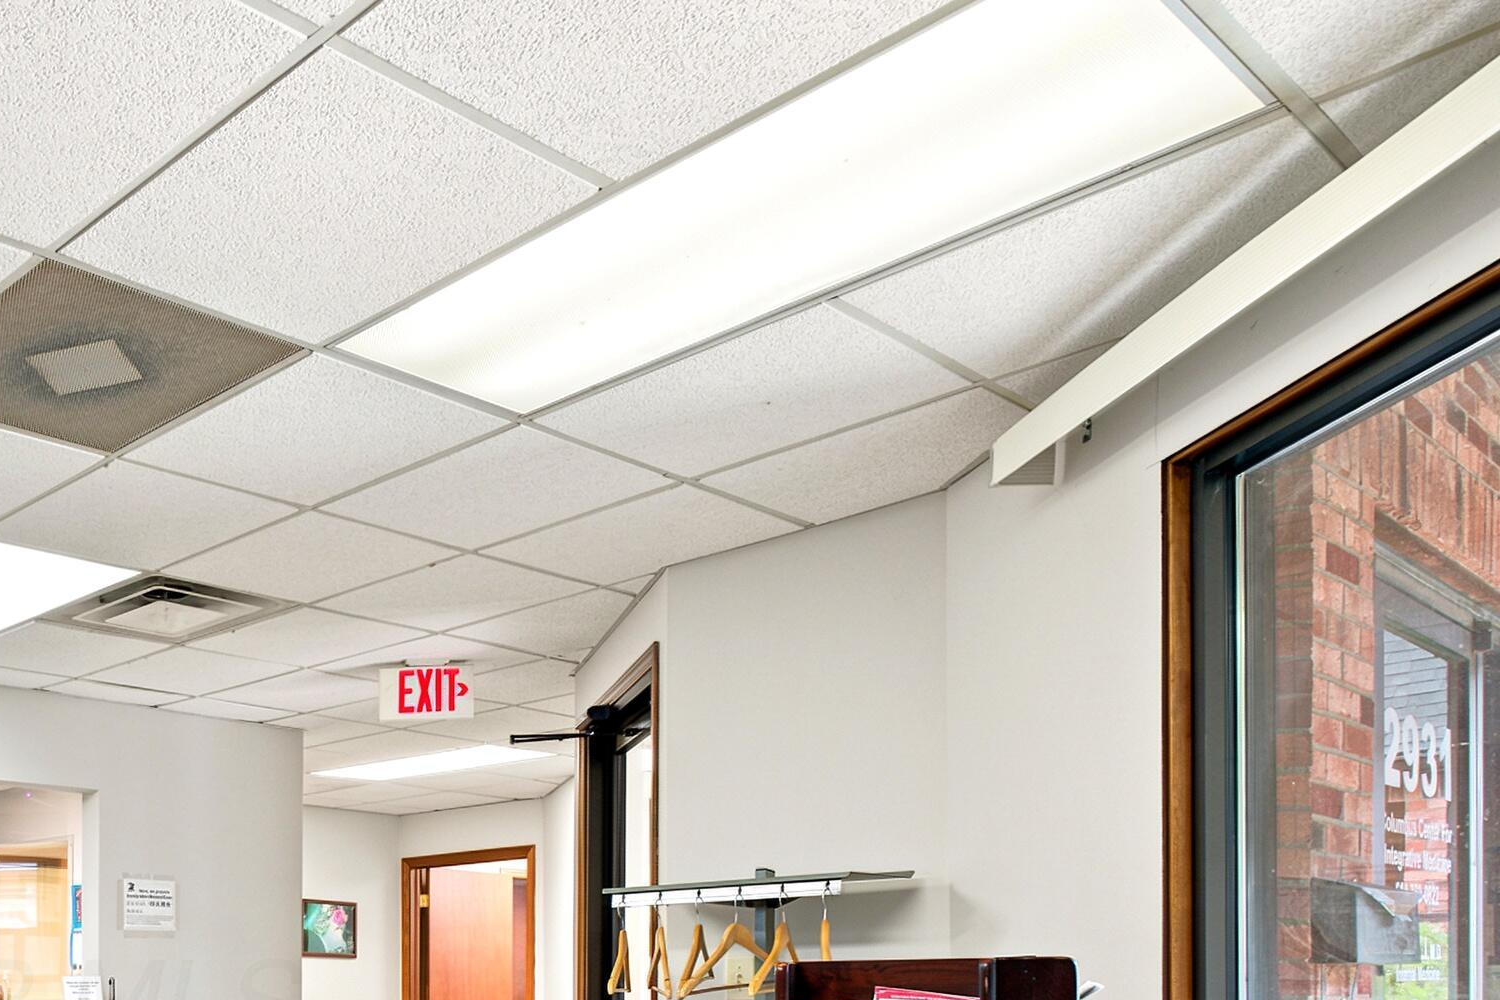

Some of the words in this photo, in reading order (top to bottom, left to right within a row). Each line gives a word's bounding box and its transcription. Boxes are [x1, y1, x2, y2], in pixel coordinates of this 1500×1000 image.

[398, 667, 460, 714] EXIT
[1384, 706, 1452, 802] 2931
[1384, 812, 1417, 837] olumbus
